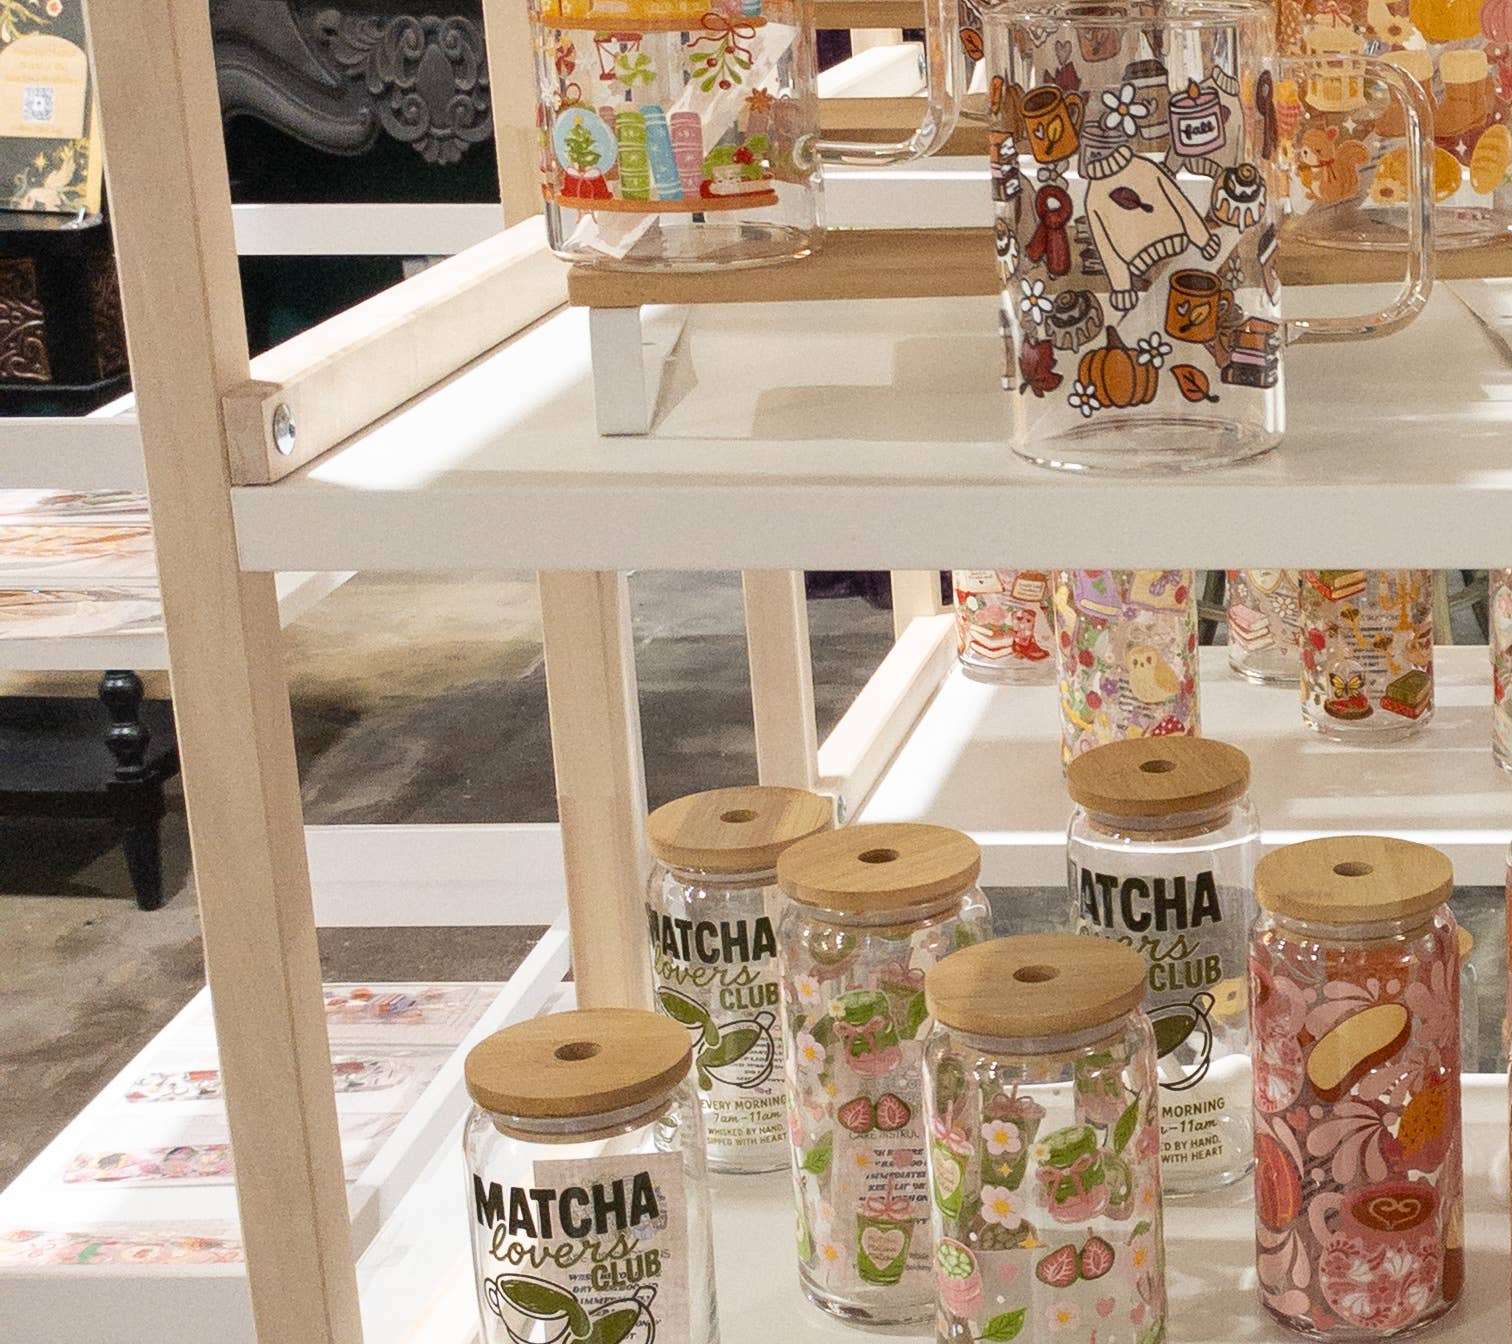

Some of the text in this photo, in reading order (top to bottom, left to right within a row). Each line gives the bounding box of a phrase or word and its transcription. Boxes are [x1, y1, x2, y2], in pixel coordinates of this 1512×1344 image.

[1149, 955, 1222, 992] CLUB
[719, 982, 779, 1010] CLUB
[735, 1095, 787, 1110] MORNING
[1162, 1097, 1225, 1118] MORNING
[1161, 1145, 1223, 1164] WITH HEART
[1174, 1141, 1187, 1151] BY
[473, 1171, 660, 1239] MATCHA
[489, 1223, 640, 1269] lovers
[591, 1249, 662, 1292] CLUB
